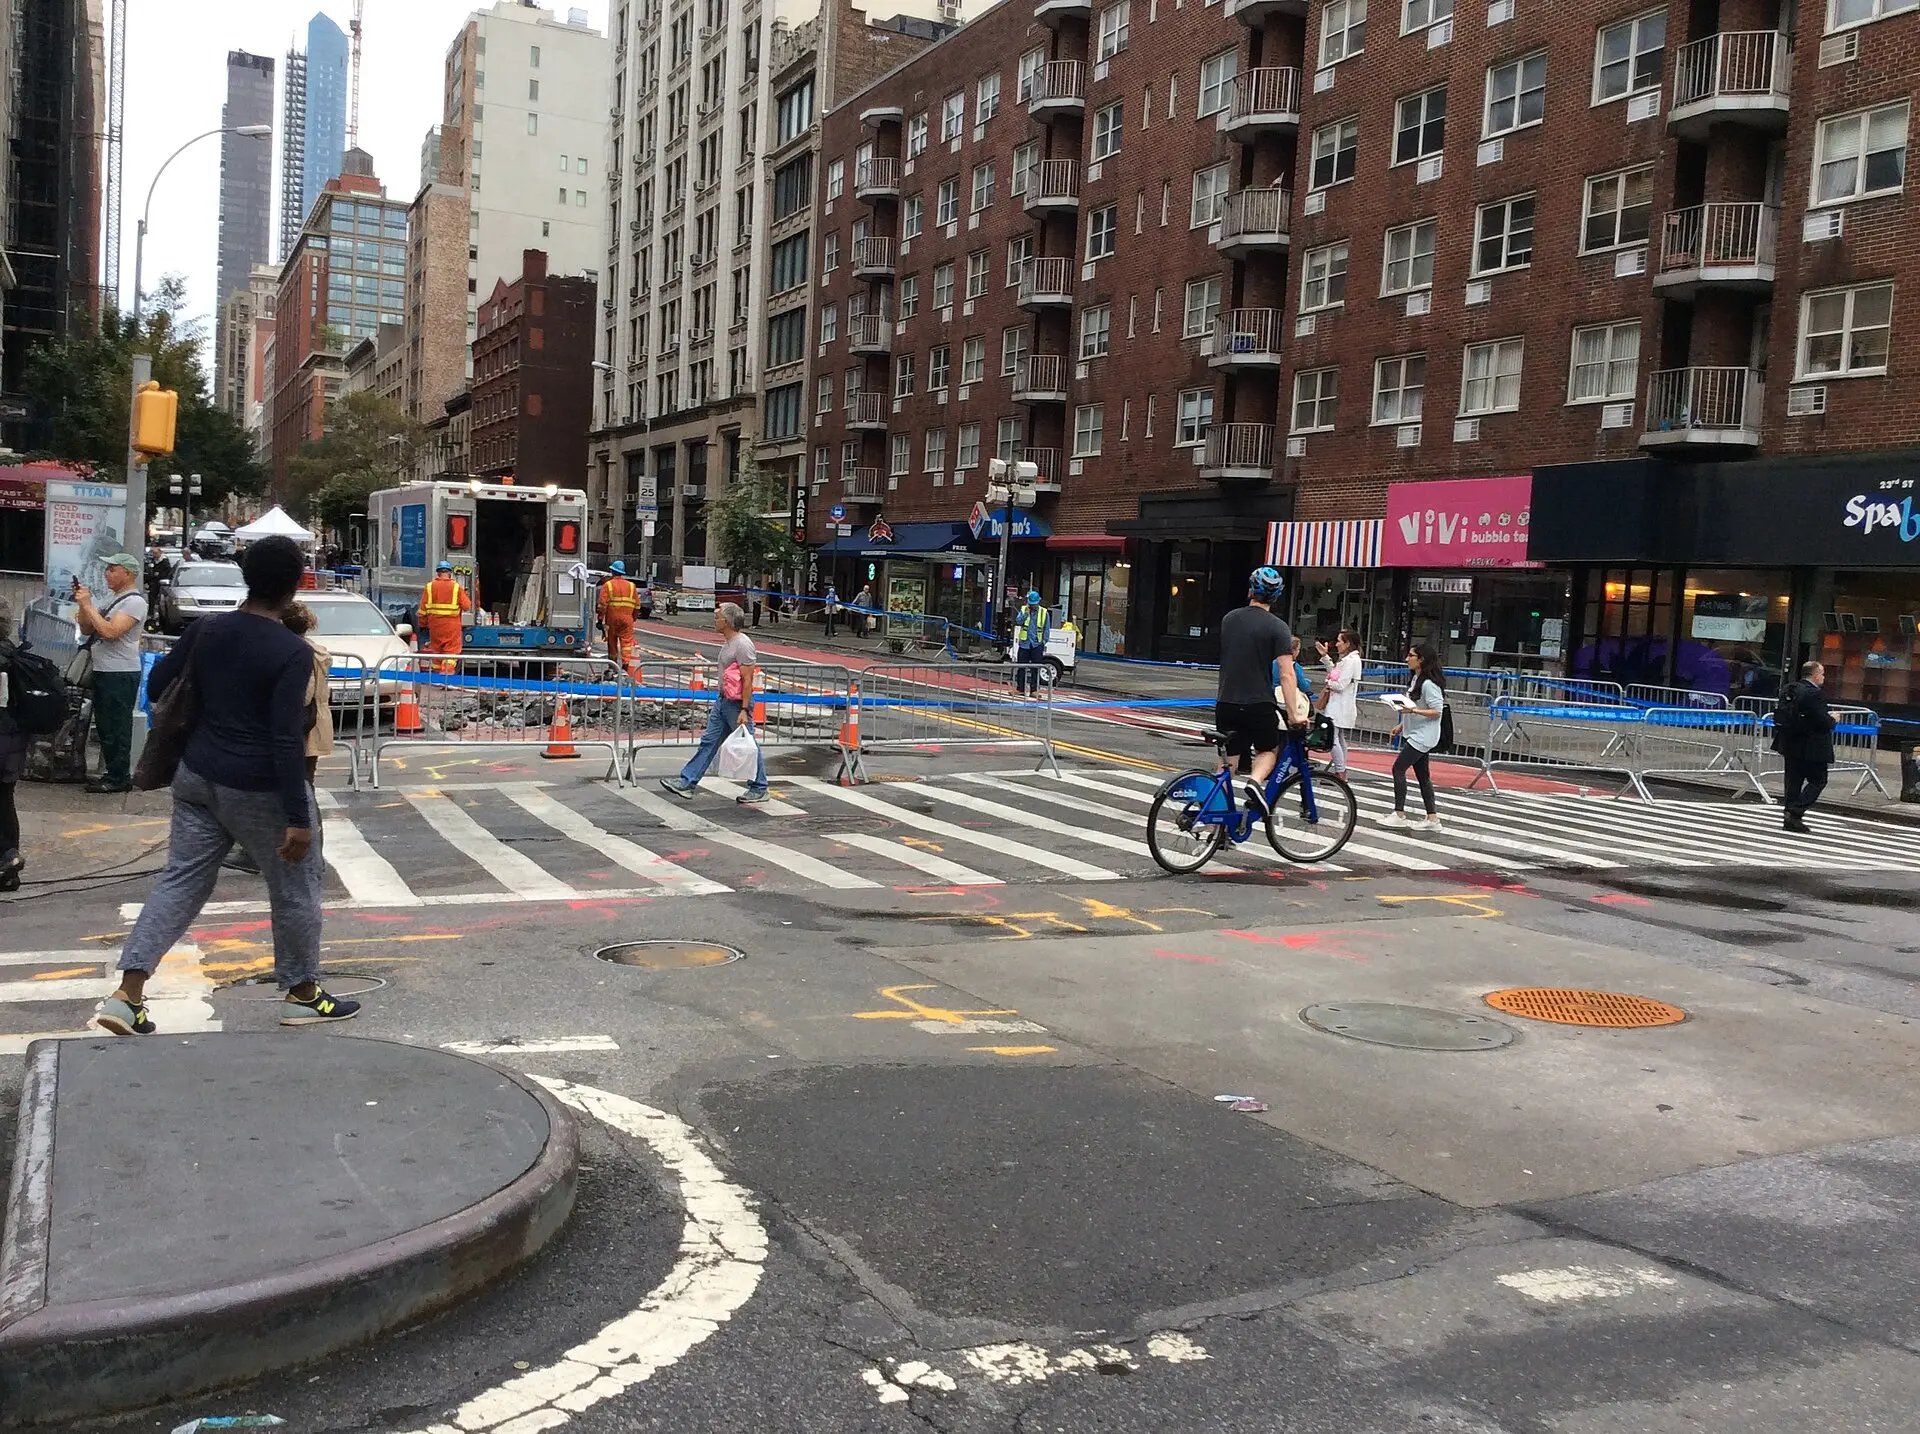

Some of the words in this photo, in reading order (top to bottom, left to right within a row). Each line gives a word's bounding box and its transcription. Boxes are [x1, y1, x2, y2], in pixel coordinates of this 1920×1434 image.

[1880, 478, 1900, 489] 23rd
[1902, 480, 1914, 488] ST
[72, 486, 113, 497] TITAN
[641, 488, 655, 497] 25
[12, 499, 37, 507] LUNCH
[53, 504, 79, 512] COLD
[796, 489, 806, 528] PARK
[53, 511, 94, 520] FILTERED
[53, 526, 93, 535] CLEANER
[1398, 508, 1469, 545] ViVi
[53, 533, 83, 541] FINISH
[1471, 530, 1510, 543] bubble
[808, 552, 818, 592] PARK
[1697, 620, 1731, 631] Eyelash
